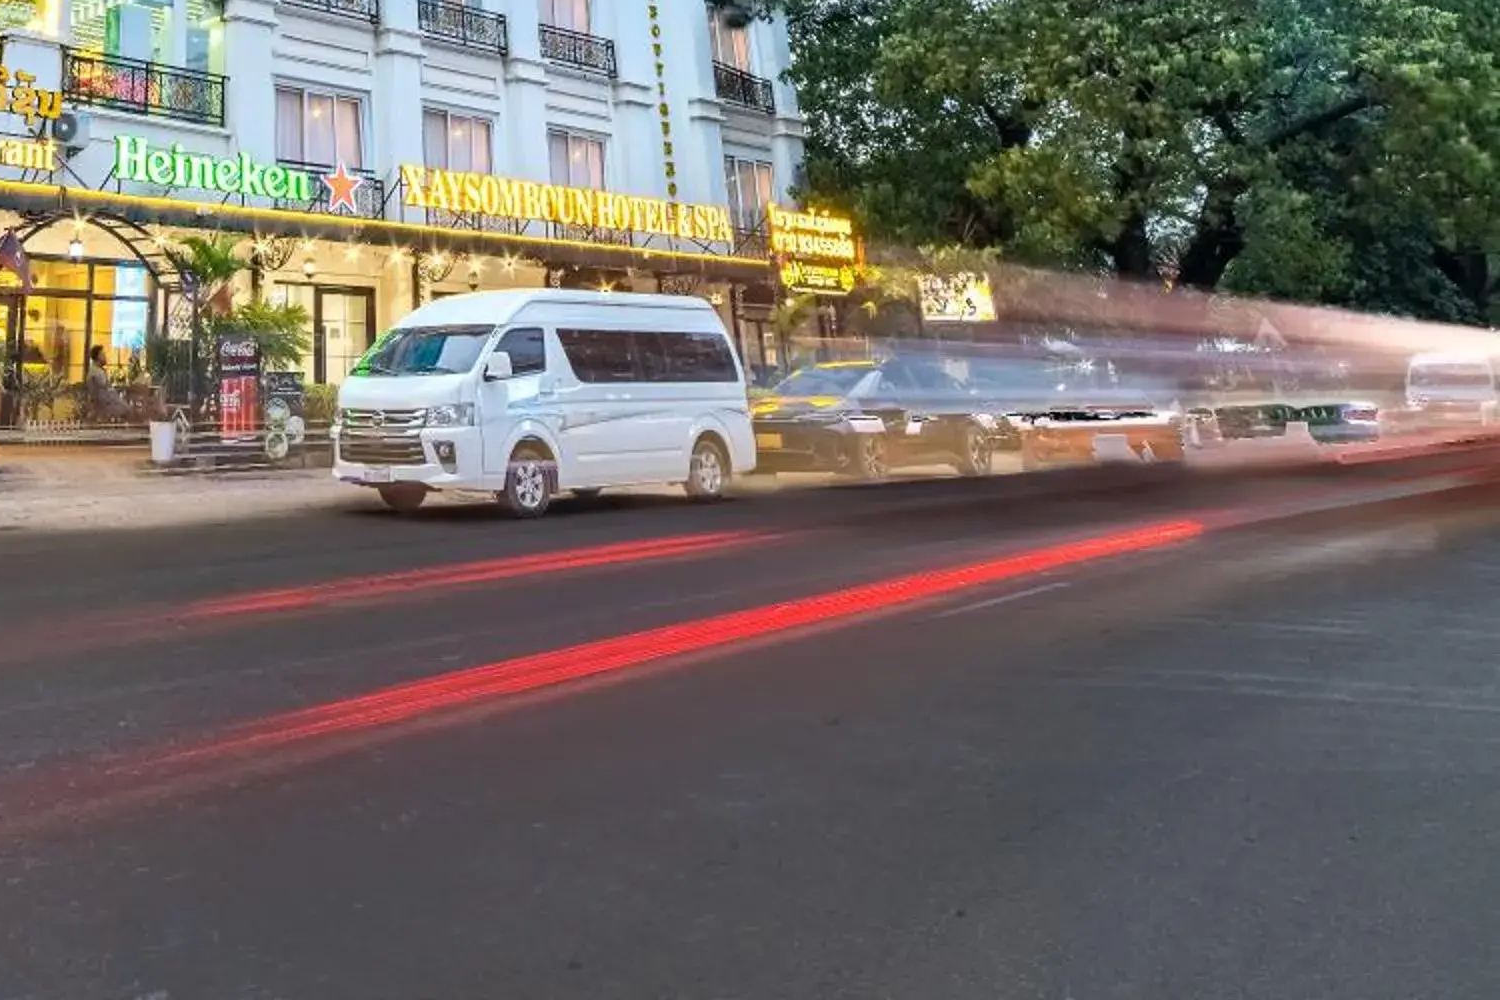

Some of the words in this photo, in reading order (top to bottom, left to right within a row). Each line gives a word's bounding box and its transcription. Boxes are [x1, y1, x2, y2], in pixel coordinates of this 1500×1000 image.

[113, 134, 312, 202] Heineken
[401, 164, 593, 224] XAYSOMBOUN
[595, 188, 676, 236] HOTEL
[676, 203, 695, 237] &
[694, 204, 734, 240] SPA
